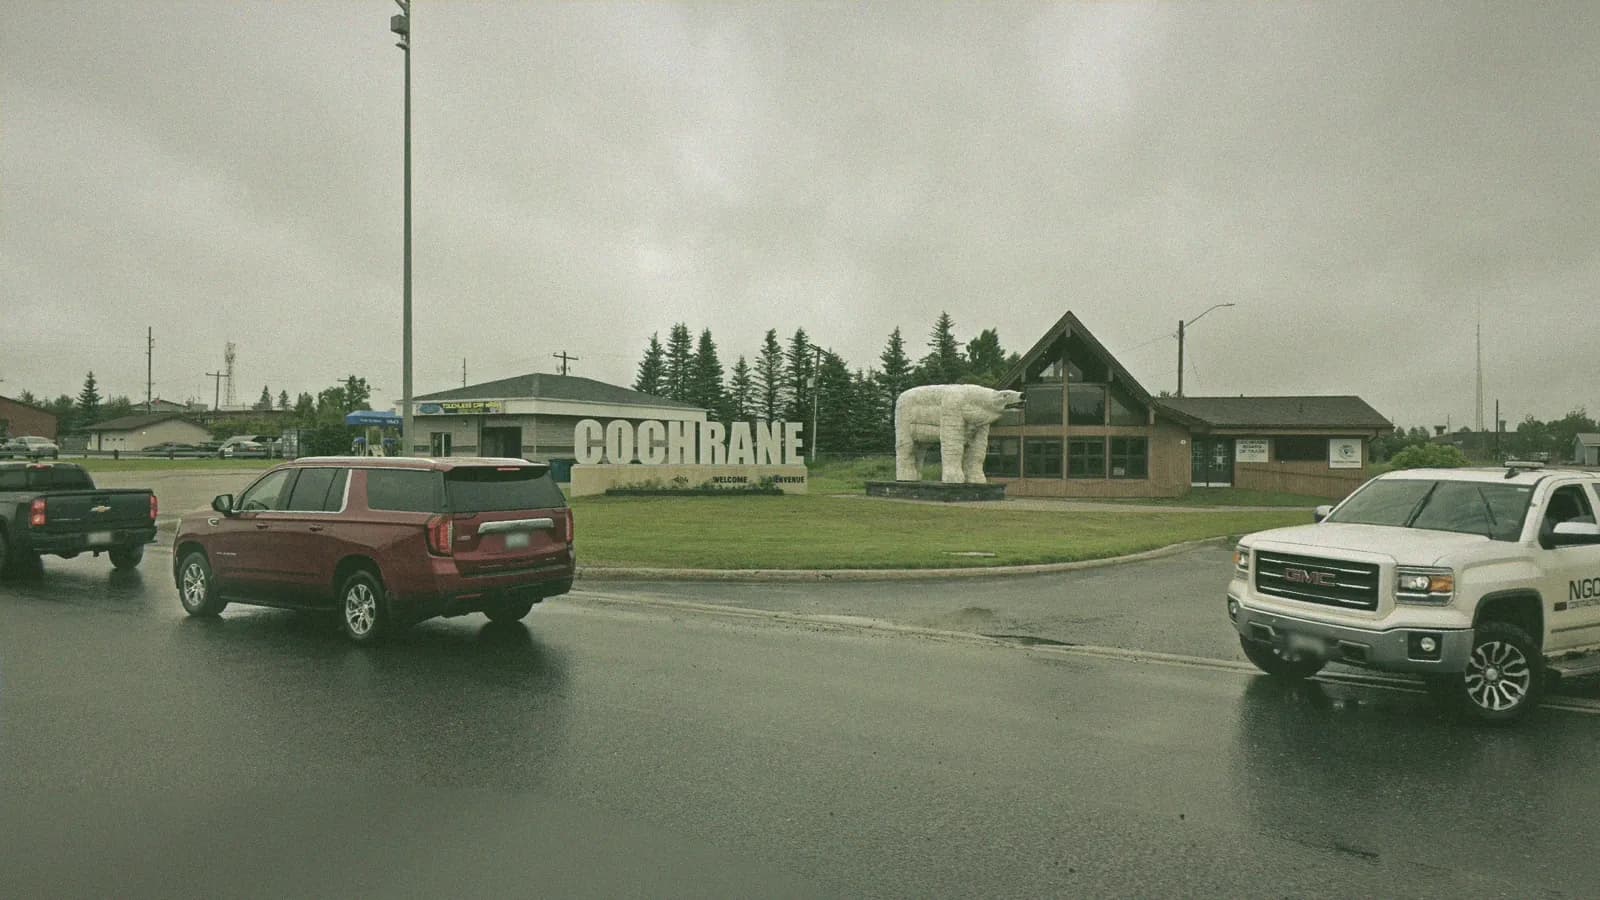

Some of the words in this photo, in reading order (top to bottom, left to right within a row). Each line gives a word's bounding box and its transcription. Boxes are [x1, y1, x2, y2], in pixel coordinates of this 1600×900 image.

[574, 419, 805, 465] COCHRANE
[712, 475, 748, 484] WELCOME
[1284, 568, 1336, 587] GMC
